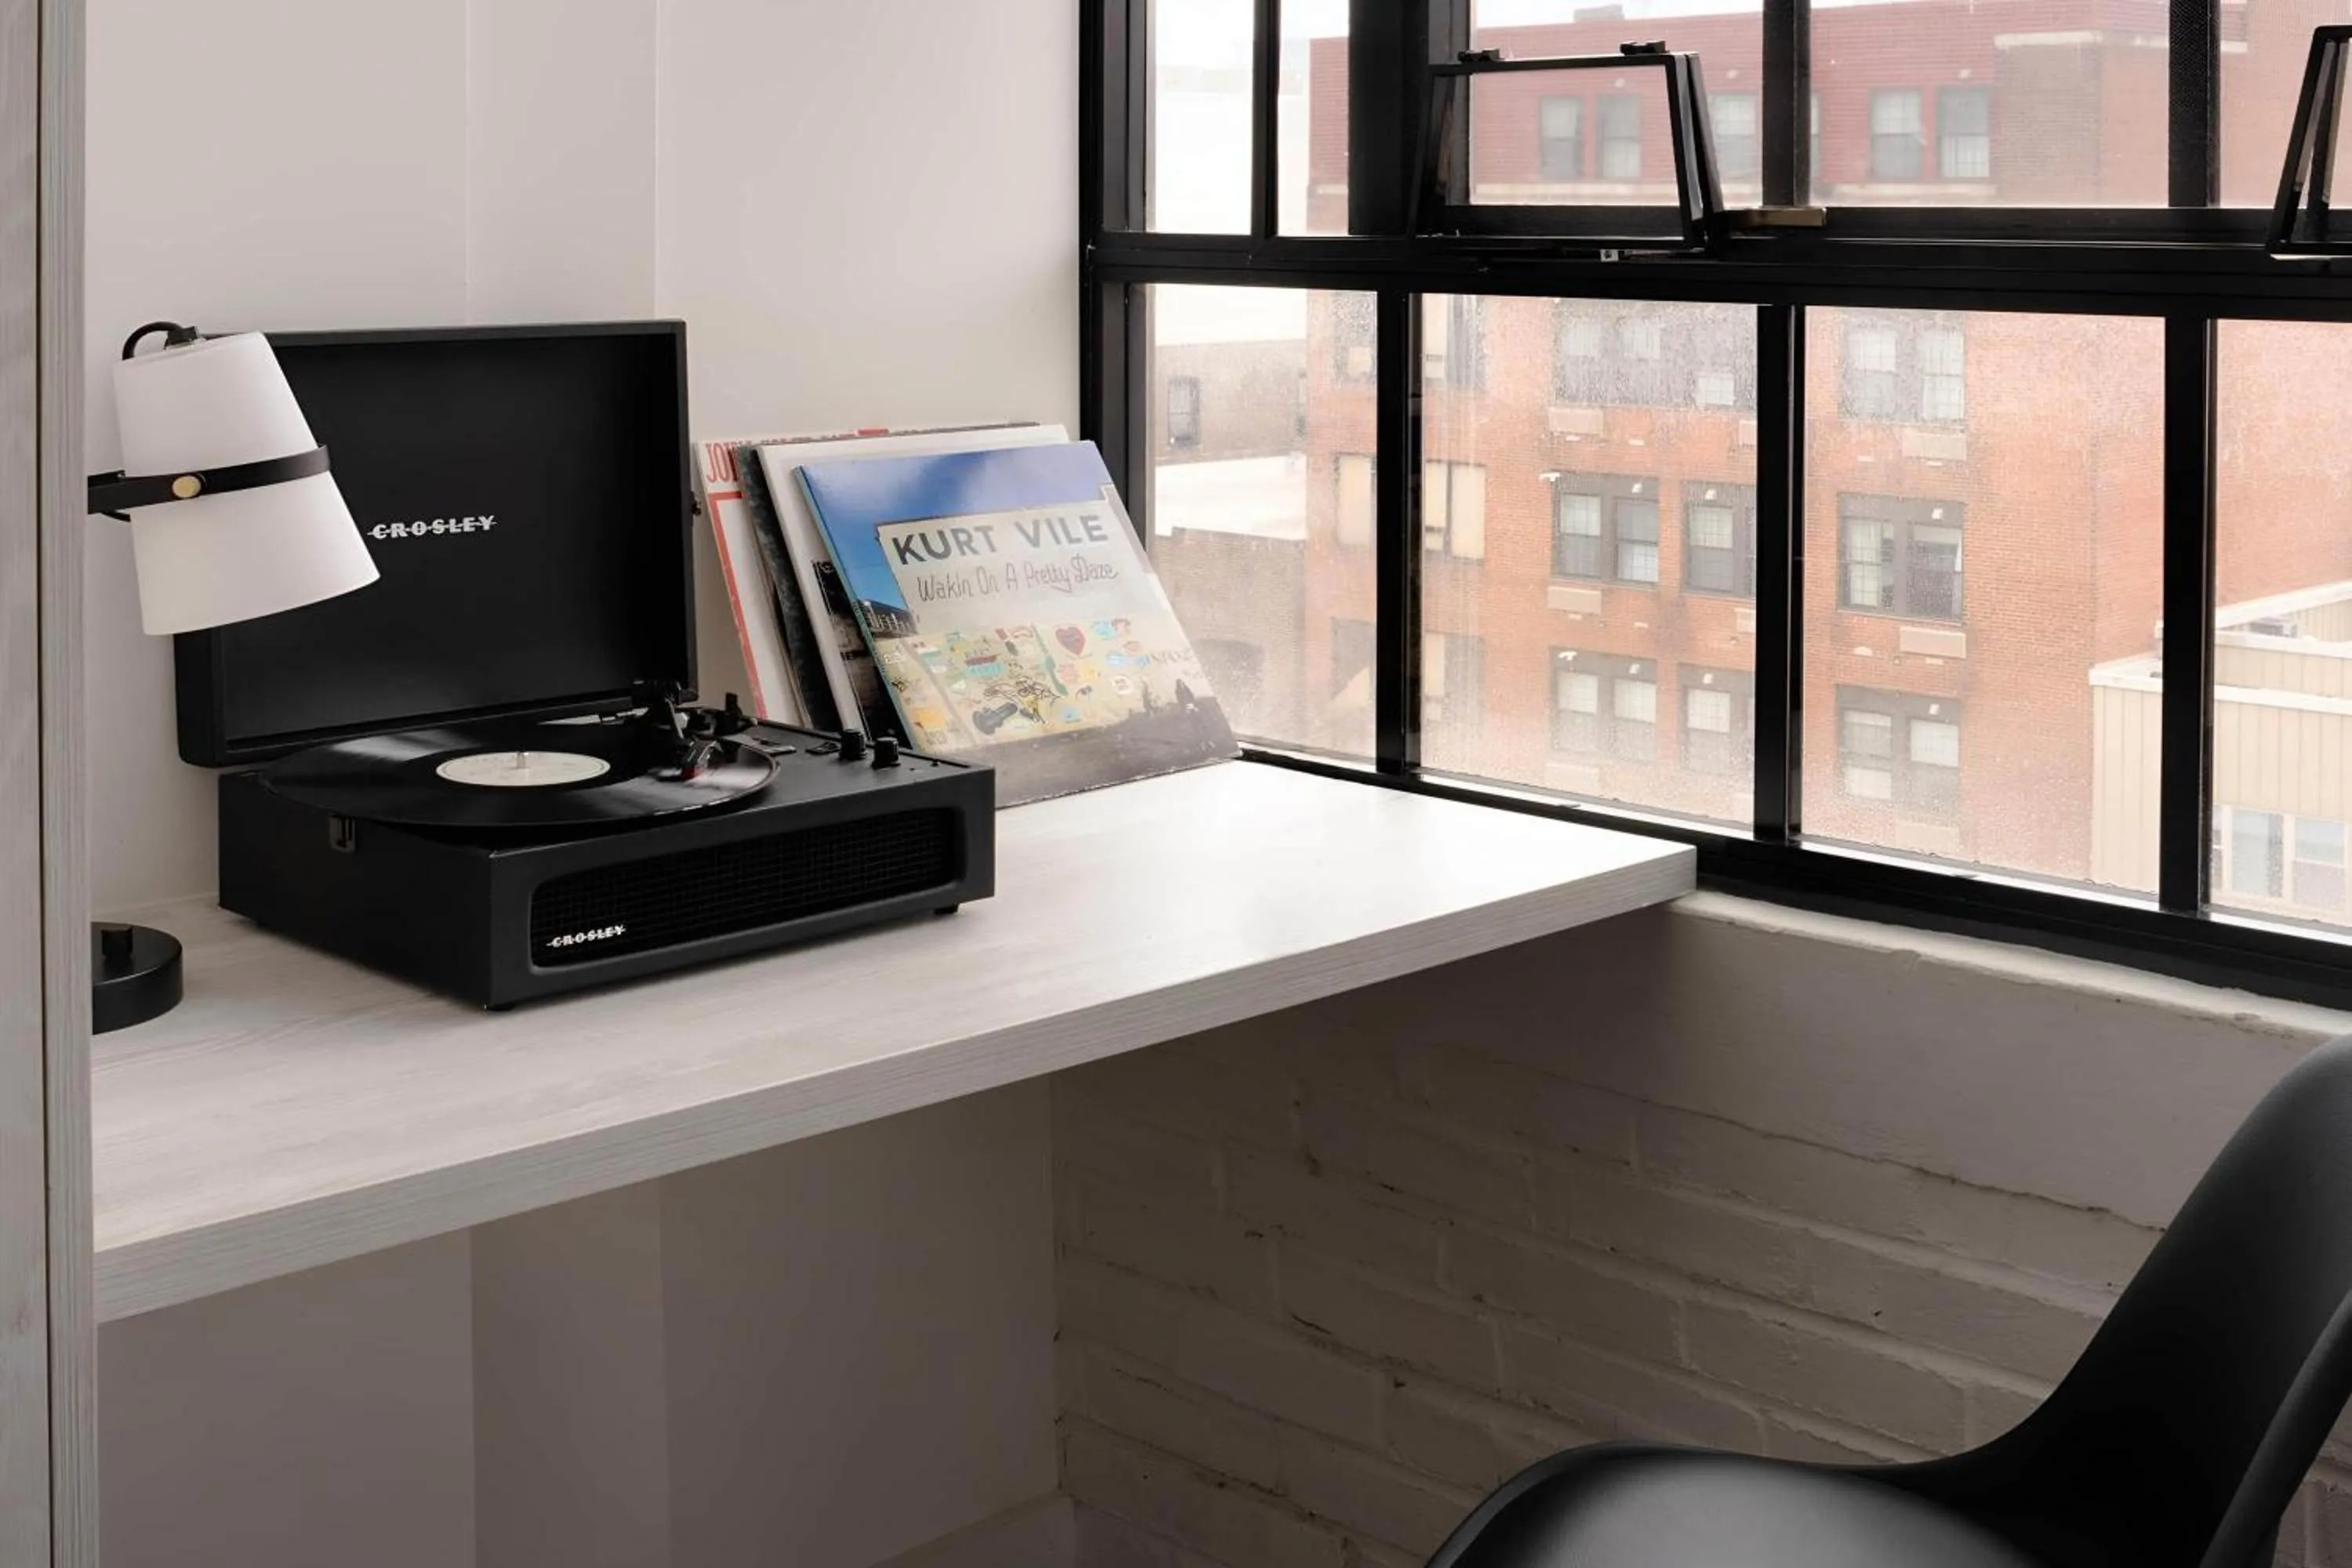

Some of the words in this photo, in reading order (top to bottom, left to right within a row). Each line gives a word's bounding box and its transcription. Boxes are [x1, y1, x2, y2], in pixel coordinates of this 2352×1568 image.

[367, 515, 497, 539] CROSLEY
[892, 525, 997, 565] KURT
[1014, 514, 1109, 548] VILE
[976, 566, 1000, 595] On
[1005, 562, 1018, 591] A
[1024, 559, 1073, 593] Pretty
[1070, 552, 1119, 584] Daze
[546, 924, 626, 947] CROSLEY
